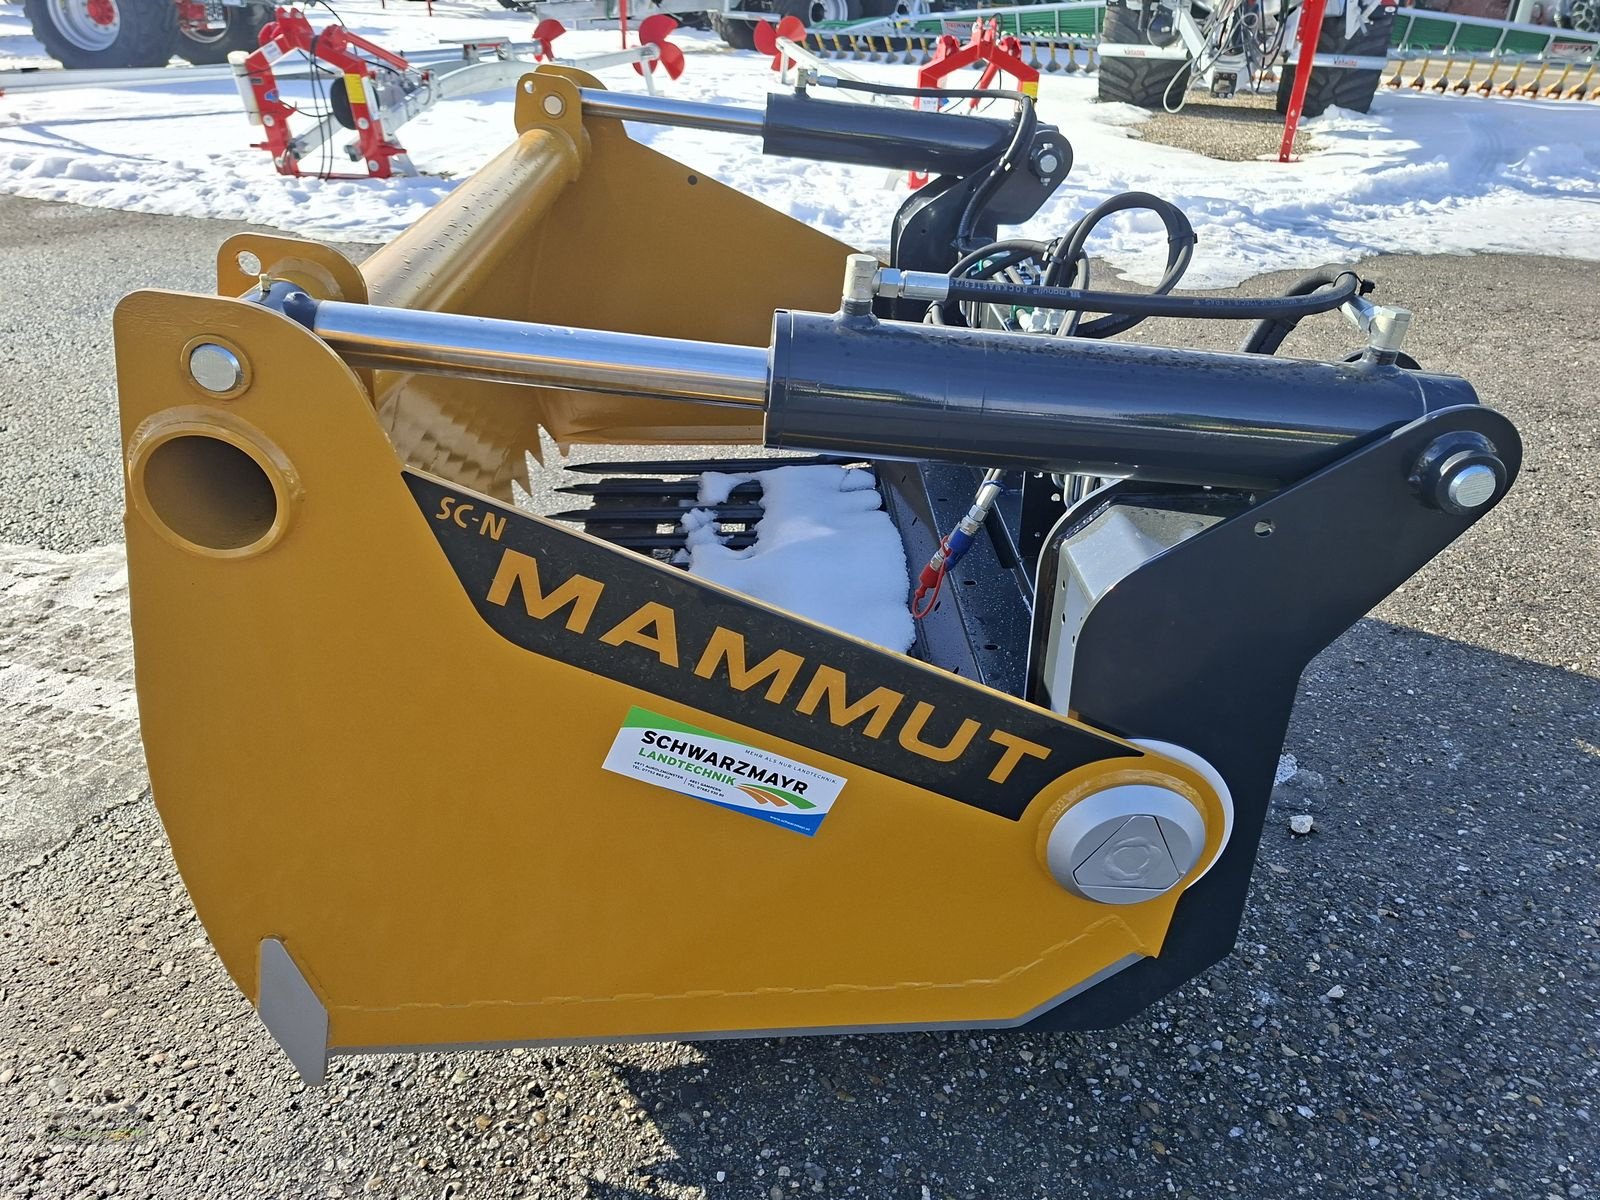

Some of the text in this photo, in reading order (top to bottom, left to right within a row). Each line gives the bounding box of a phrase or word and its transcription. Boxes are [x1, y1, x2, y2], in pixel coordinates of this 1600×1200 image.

[436, 497, 507, 541] SC-N
[486, 548, 1052, 784] MAMMUT
[638, 747, 737, 786] LANDTECHNIK
[641, 730, 808, 795] SCHWARZMAYR
[745, 749, 763, 759] MEHR
[764, 756, 777, 764] ALS
[778, 760, 792, 769] NUR
